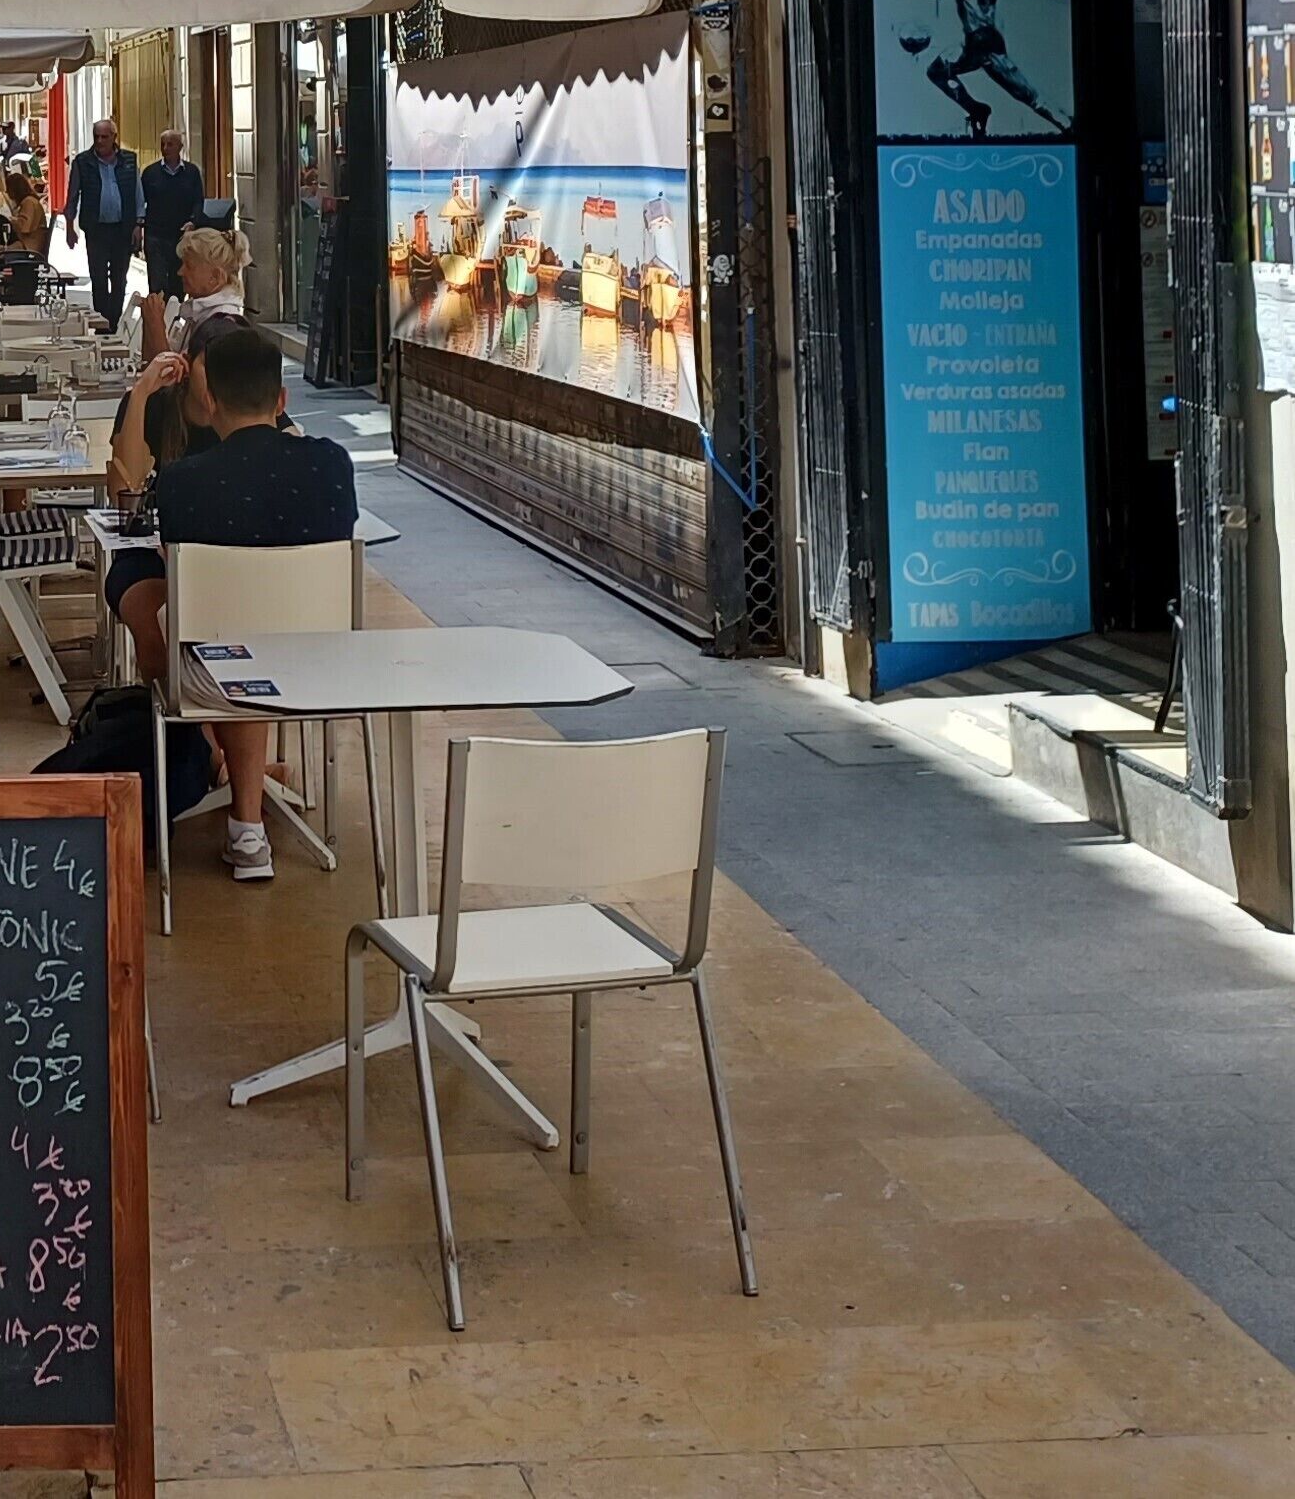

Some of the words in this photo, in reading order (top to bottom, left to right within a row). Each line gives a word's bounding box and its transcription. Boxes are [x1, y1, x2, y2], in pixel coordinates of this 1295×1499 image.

[933, 189, 1026, 224] ASADO
[915, 230, 1044, 253] Empanadas
[929, 258, 1032, 282] CHORIPAN
[939, 290, 1024, 314] Molleja
[906, 323, 968, 347] VACIO
[926, 354, 1040, 375] Provoleta
[900, 383, 993, 401] Verduras
[998, 381, 1066, 399] asadas
[928, 409, 1042, 433] MILANESAS
[963, 442, 1009, 461] Flan
[936, 469, 1039, 494] PANQUEQUES
[983, 500, 1012, 519] de
[1018, 502, 1060, 522] pan
[933, 528, 1046, 548] CHOCOTORTA
[907, 602, 959, 628] TAPAS
